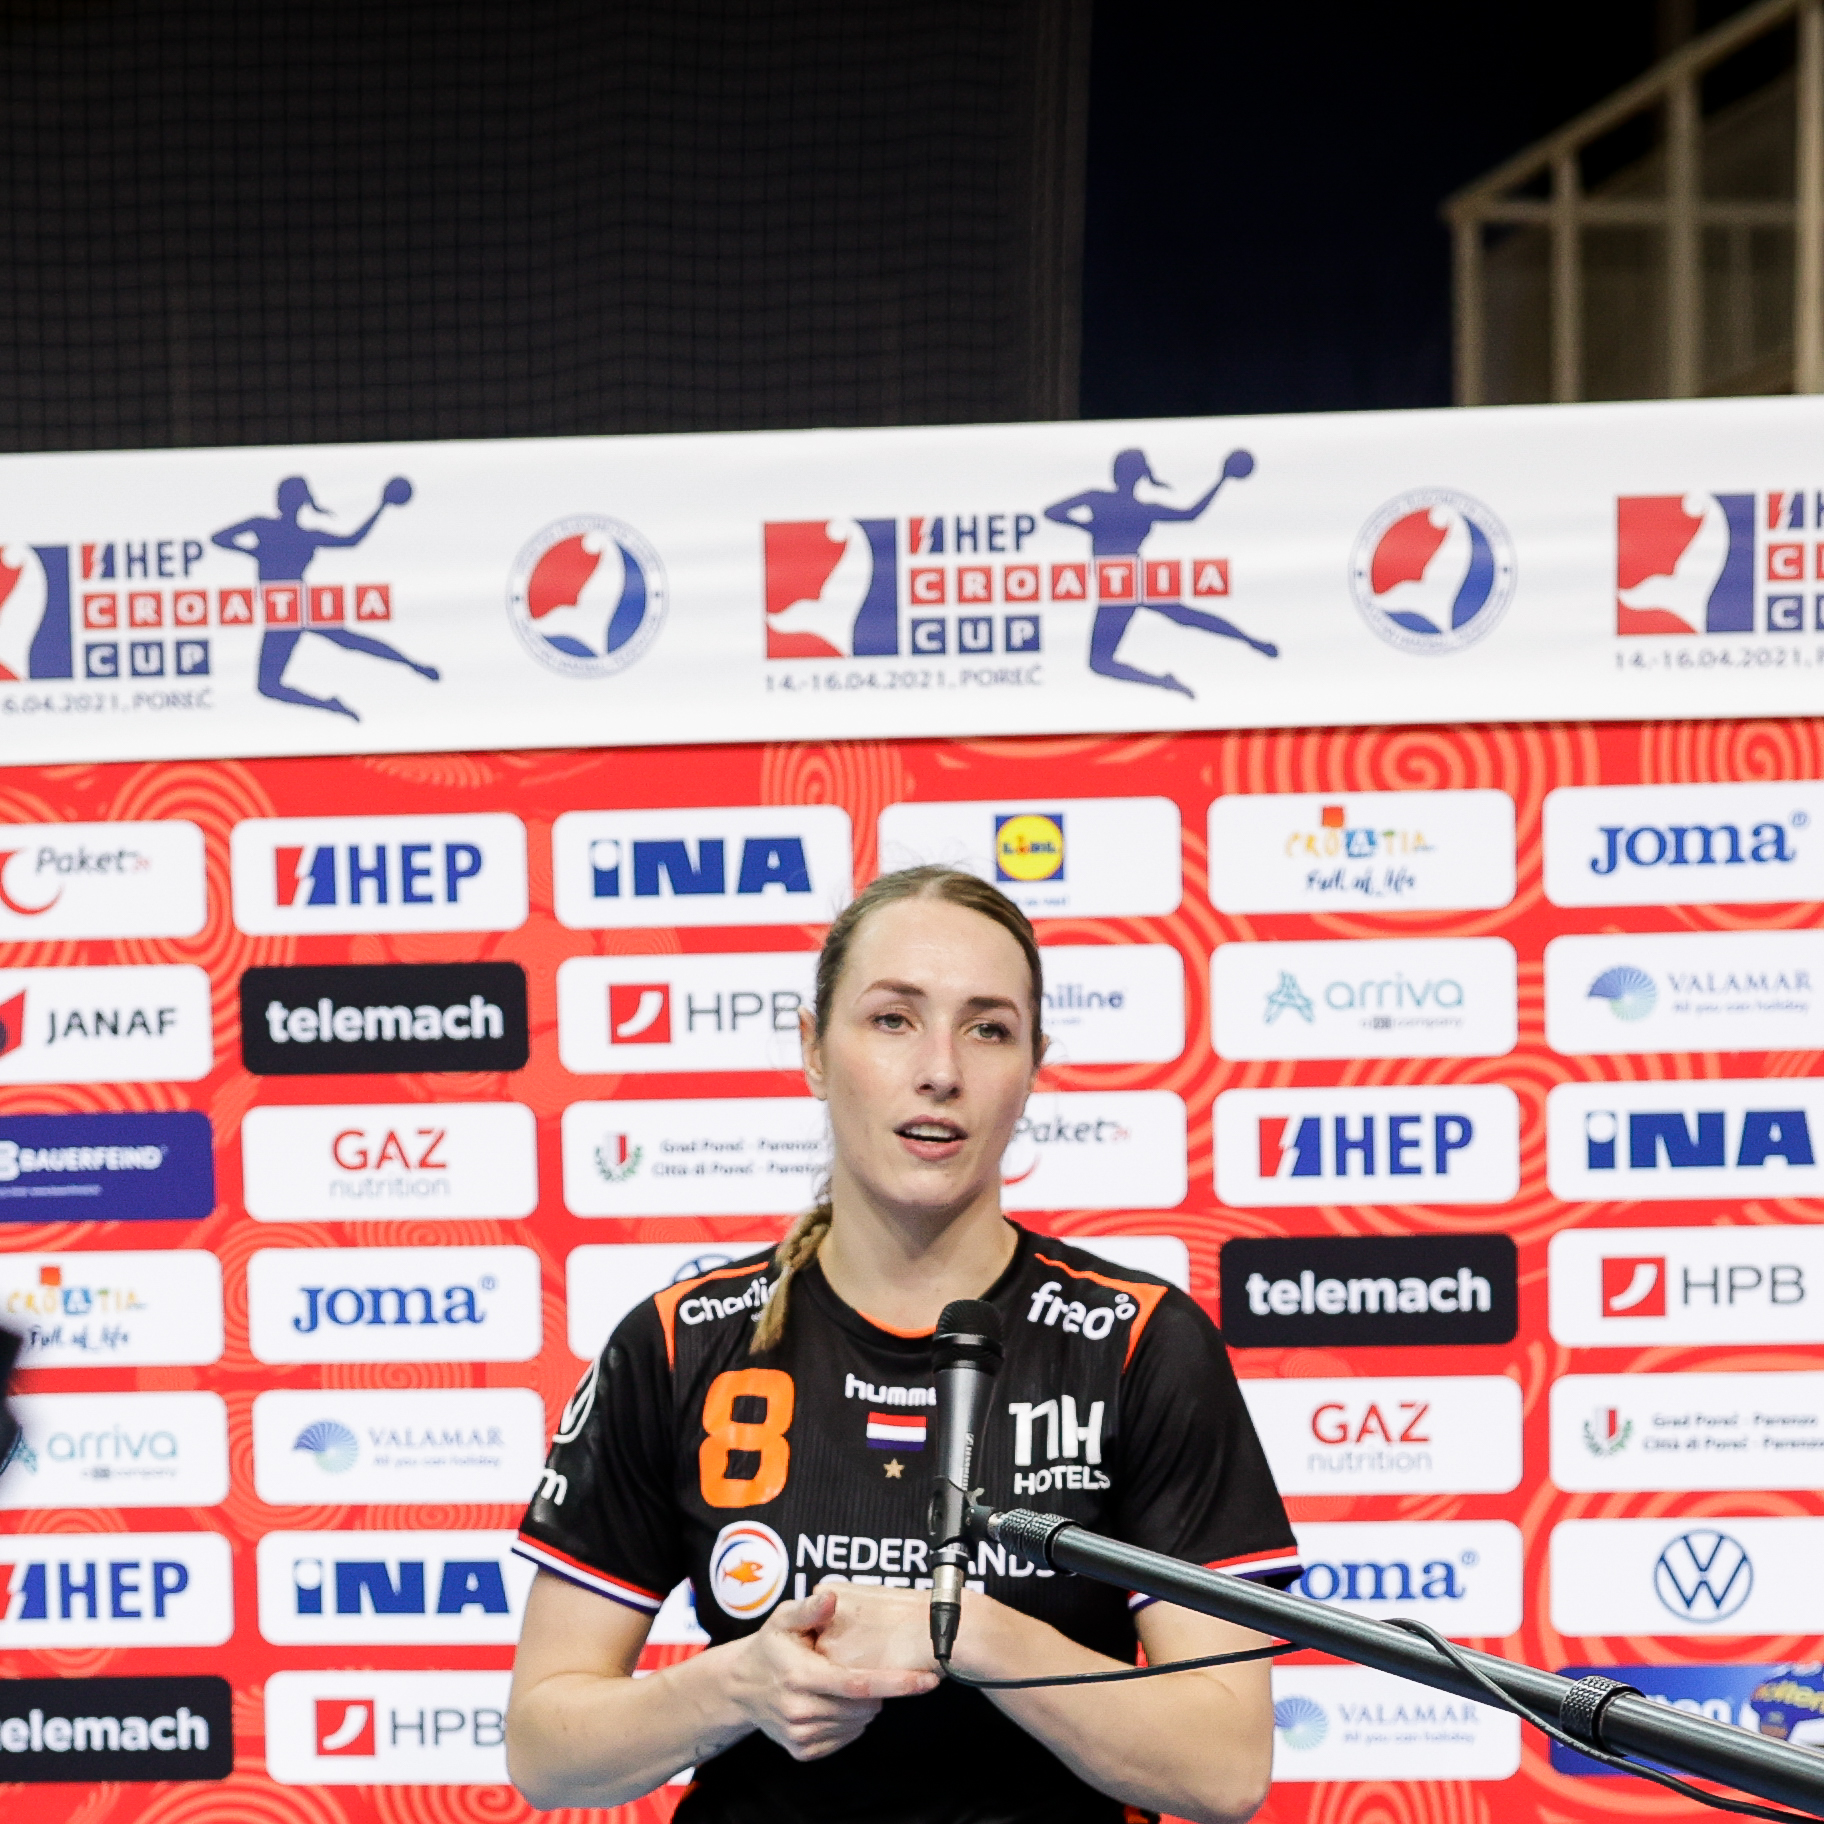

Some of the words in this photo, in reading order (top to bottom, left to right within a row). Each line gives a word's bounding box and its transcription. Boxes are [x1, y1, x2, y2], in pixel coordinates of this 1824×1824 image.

[955, 513, 1036, 554] HEP
[125, 539, 204, 579] HEP
[910, 557, 1231, 605] CROATIA
[83, 583, 393, 629] CROATIA
[911, 614, 1041, 654] CUP
[84, 639, 212, 679] CUP
[348, 843, 482, 906] HEP
[682, 985, 803, 1034] HPB
[1325, 972, 1464, 1010] arriva
[44, 1005, 179, 1044] JANAF
[265, 994, 504, 1043] telemach
[19, 1145, 164, 1172] BAUERFEIND
[332, 1129, 447, 1171] GAZ
[1334, 1113, 1474, 1177] HEP
[329, 1171, 448, 1198] nutrition
[1245, 1267, 1491, 1316] telemach
[1683, 1265, 1806, 1305] HPB
[48, 1423, 178, 1461] arriva
[700, 1368, 794, 1508] 8
[1311, 1403, 1430, 1445] GAZ
[1308, 1443, 1432, 1472] nutrition
[1013, 1464, 1112, 1496] HOTELS
[58, 1561, 190, 1620] HEP
[1300, 1558, 1468, 1604] oma
[390, 1709, 507, 1747] HPB
[1338, 1703, 1478, 1724] VALAMAR
